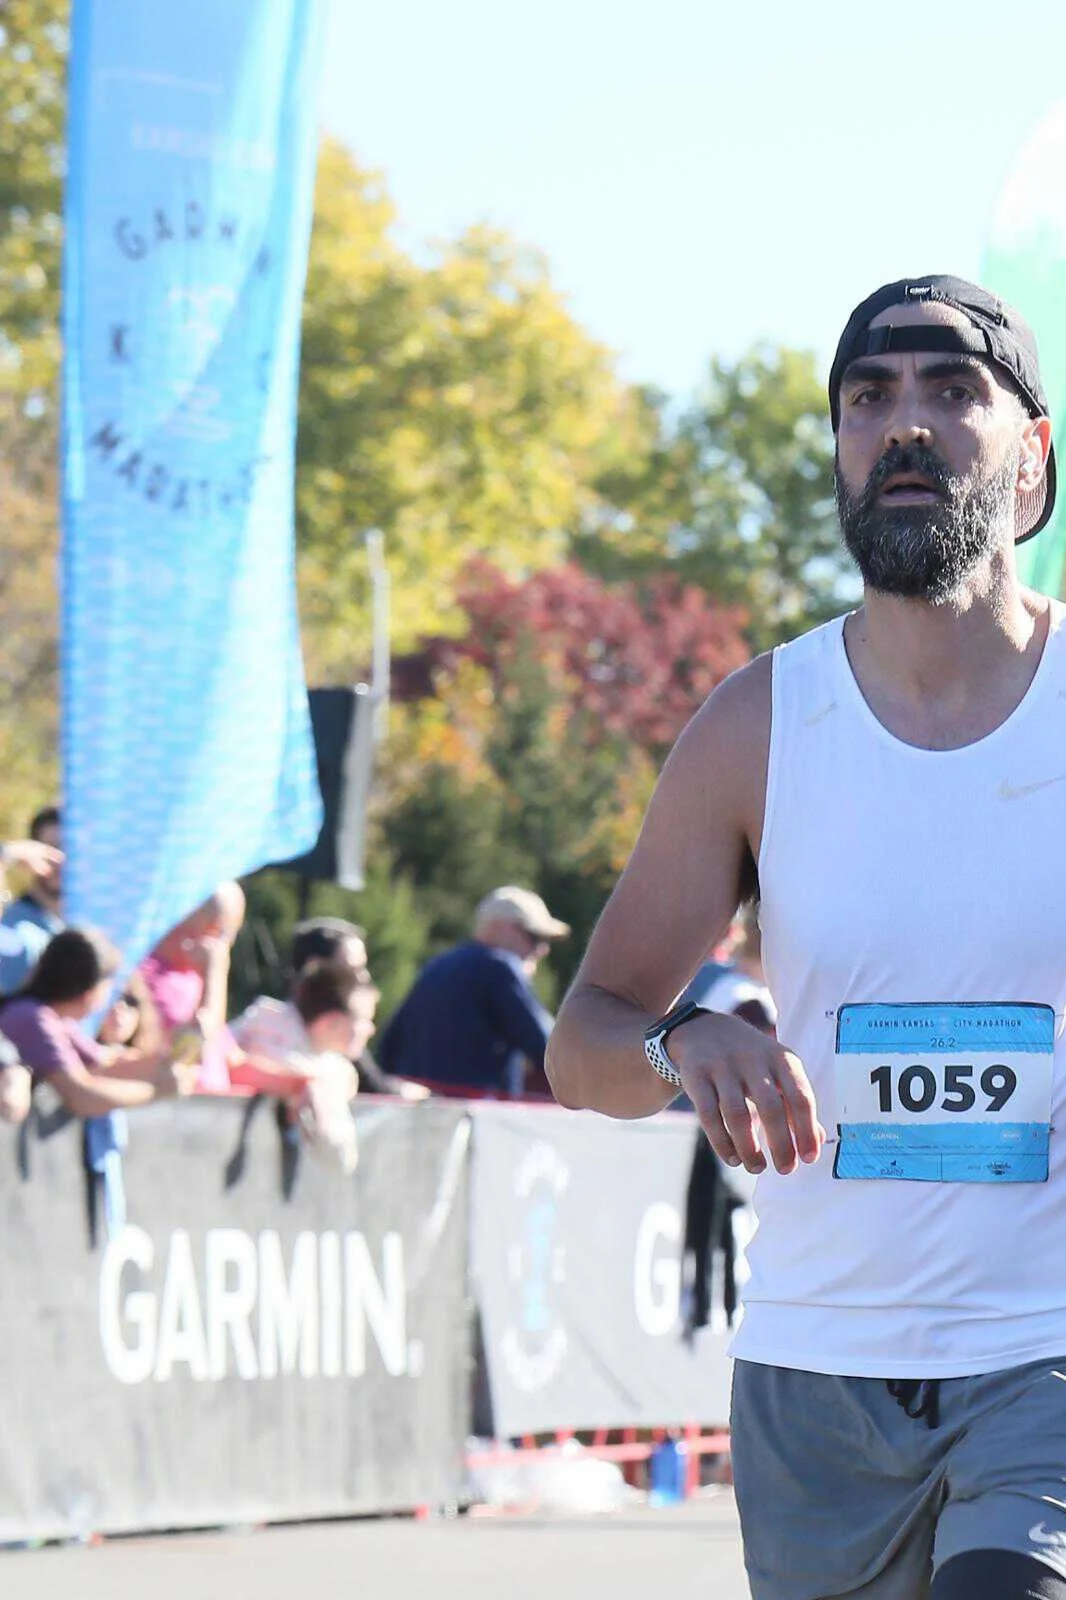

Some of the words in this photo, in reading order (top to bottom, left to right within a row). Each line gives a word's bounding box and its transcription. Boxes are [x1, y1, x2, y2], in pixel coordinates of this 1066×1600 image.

[903, 1020, 935, 1028] KANSAS
[954, 1019, 972, 1028] CITY
[976, 1019, 1021, 1028] MARATHON
[930, 1037, 956, 1048] 26.2
[870, 1065, 1017, 1113] 1059
[100, 1224, 409, 1384] GARMIN
